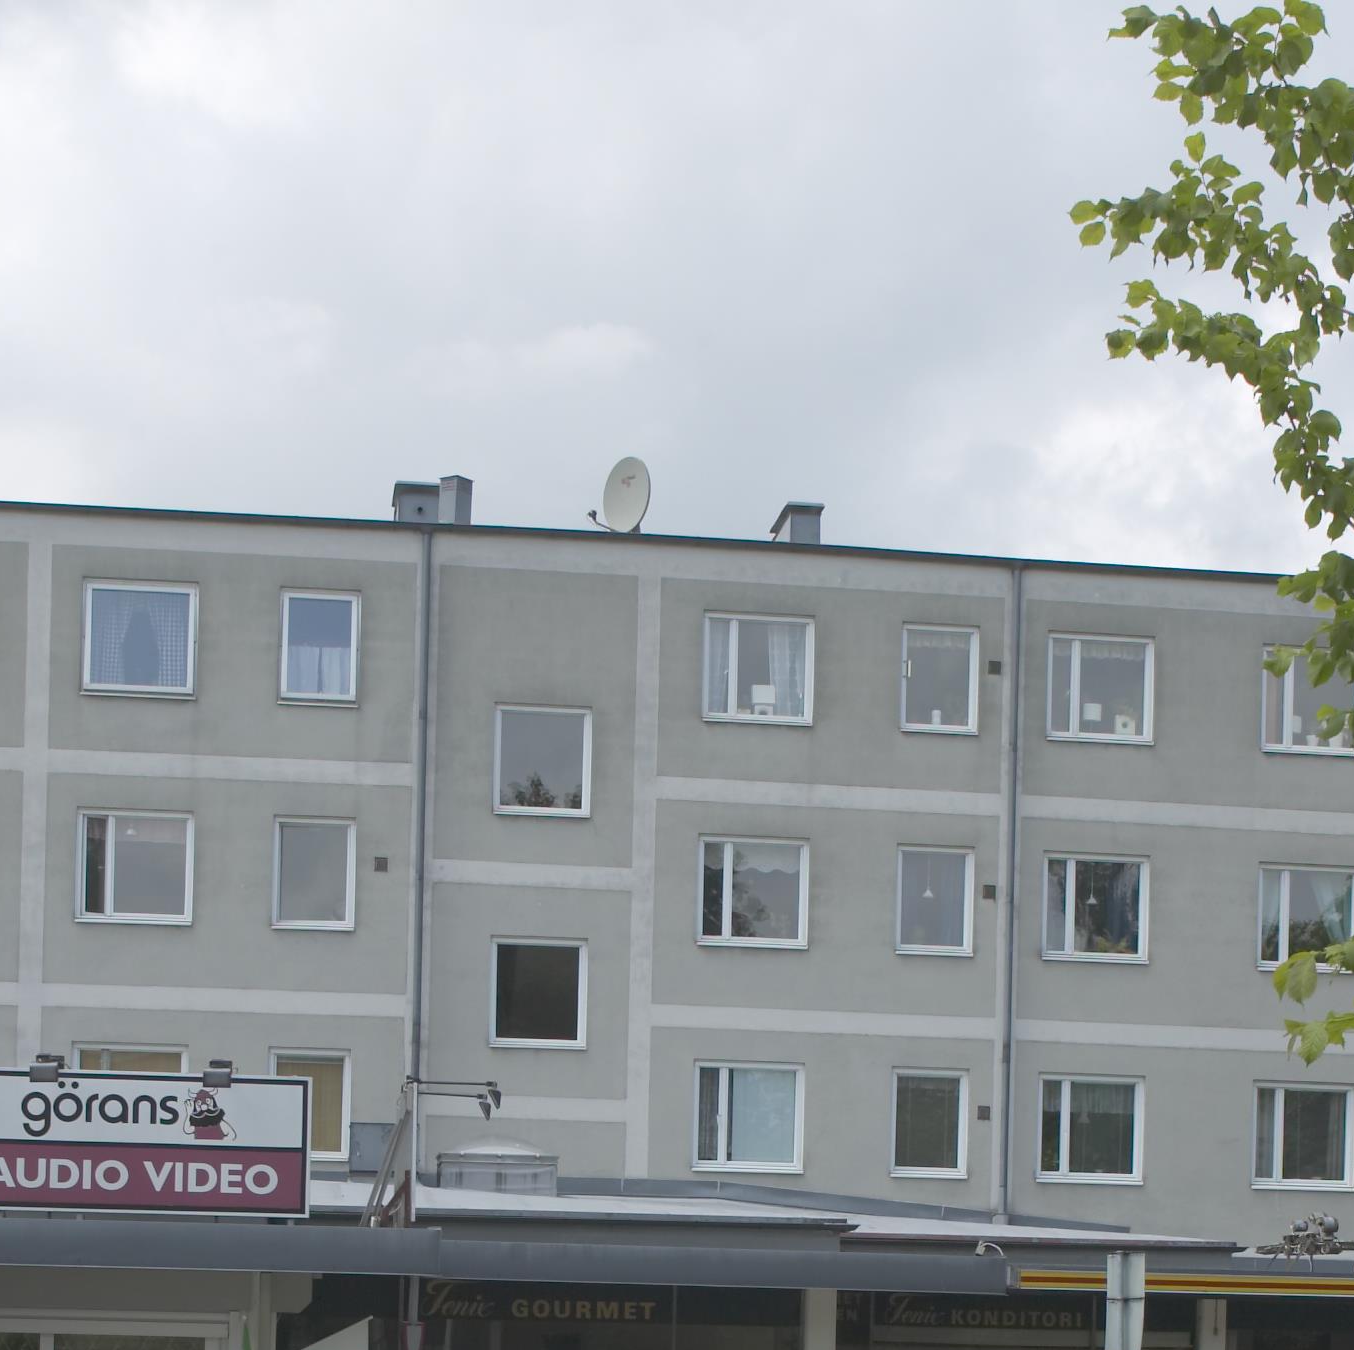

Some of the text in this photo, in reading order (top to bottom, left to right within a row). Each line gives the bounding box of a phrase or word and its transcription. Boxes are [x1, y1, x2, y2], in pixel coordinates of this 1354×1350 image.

[21, 1081, 180, 1137] görans
[142, 1160, 280, 1196] VIDEO
[511, 1299, 657, 1321] GOURMET
[950, 1308, 1083, 1328] KONDITORI
